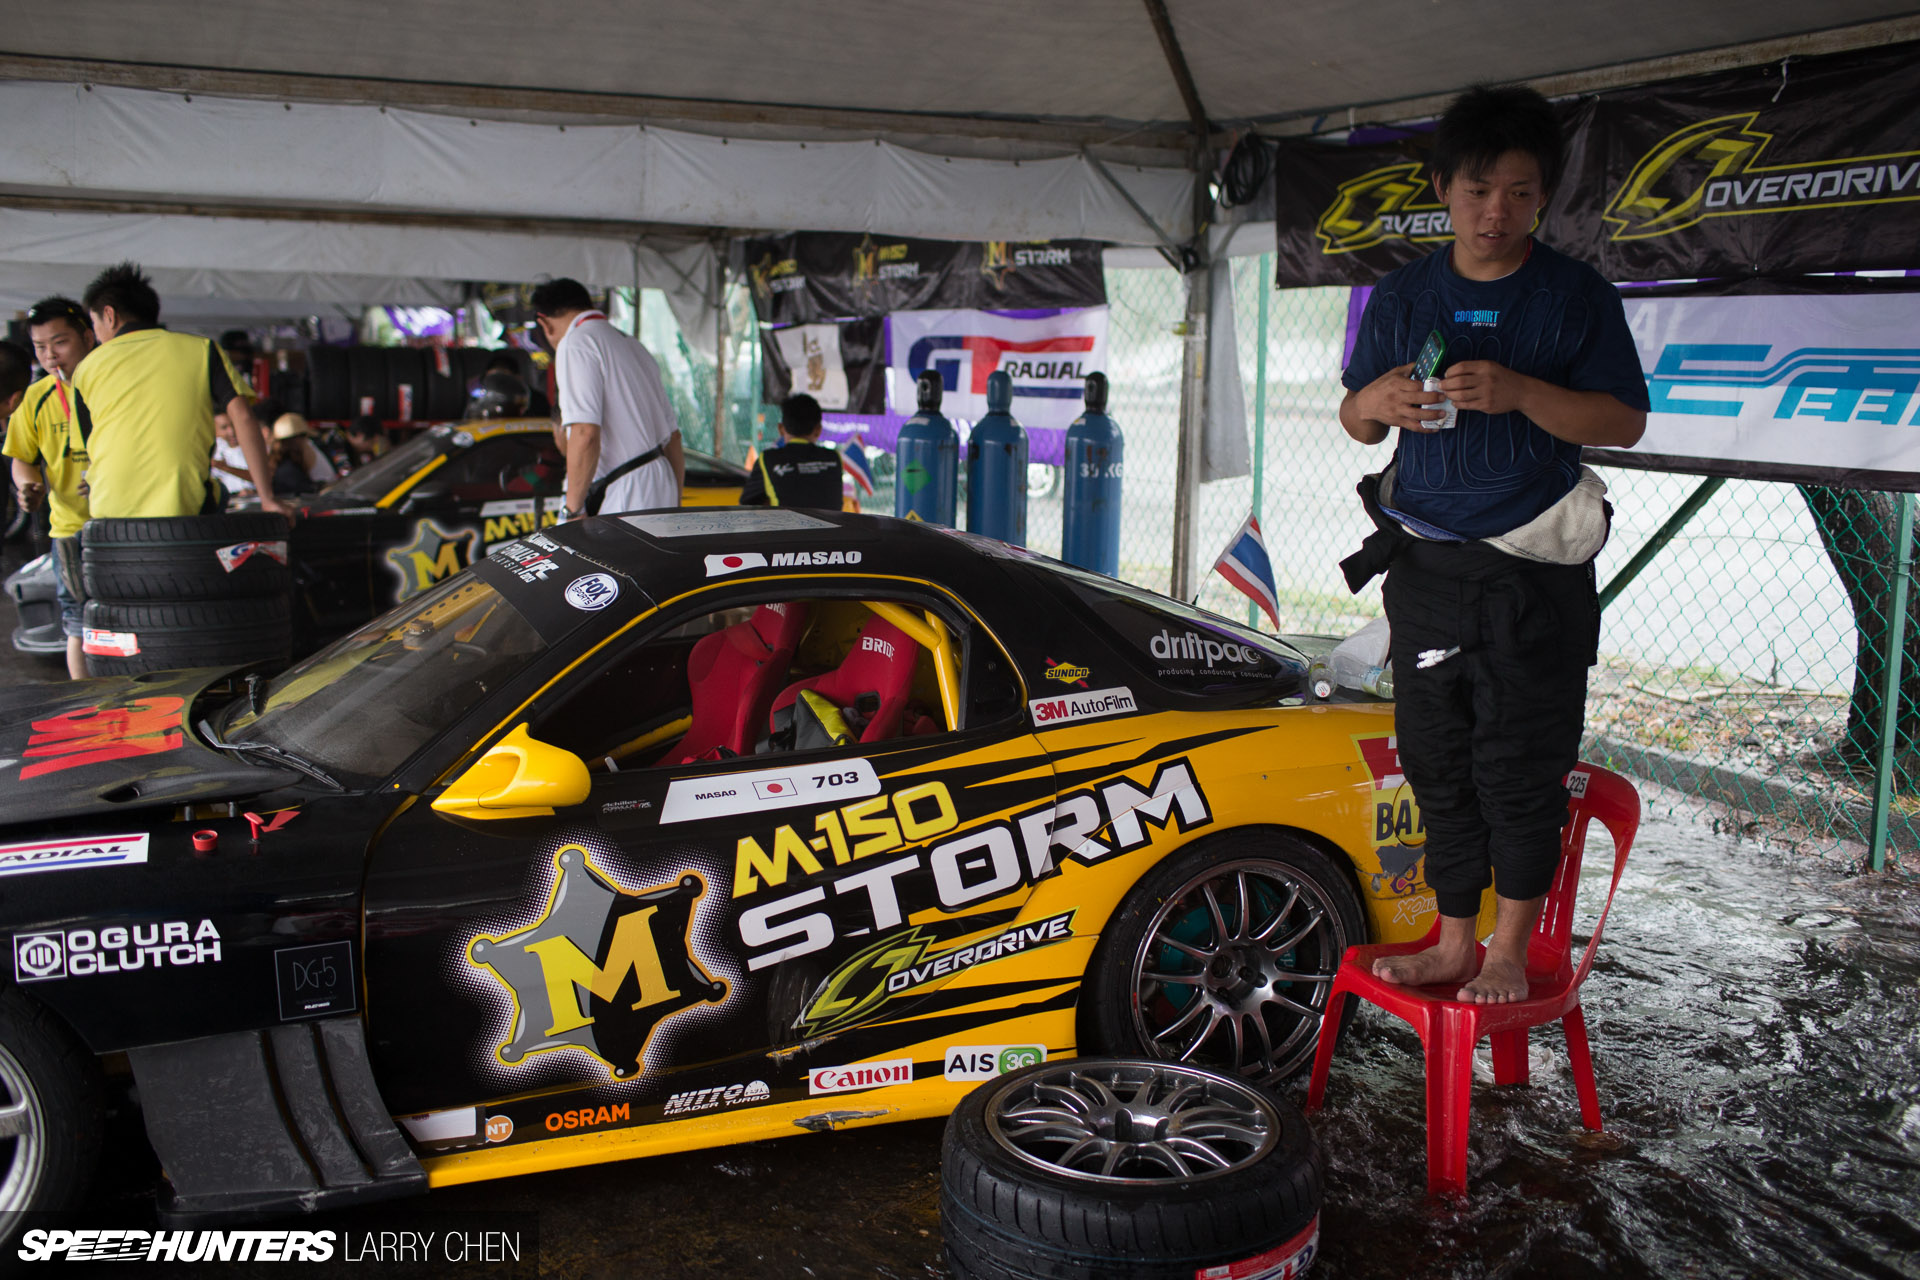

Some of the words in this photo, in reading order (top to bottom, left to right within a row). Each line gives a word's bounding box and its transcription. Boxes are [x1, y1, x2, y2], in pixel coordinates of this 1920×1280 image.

[1705, 161, 1920, 208] OVERDRIV
[1015, 248, 1072, 267] STORM
[1454, 309, 1501, 323] COOLSHIRT
[1003, 360, 1088, 380] RADIAL
[771, 551, 862, 567] MASAO
[571, 586, 593, 606] SPORTS
[580, 578, 612, 601] FOX
[1046, 667, 1089, 679] SUNOCO
[1158, 667, 1195, 677] producing
[1199, 668, 1237, 678] conducting
[1035, 700, 1069, 722] 3M
[1071, 694, 1134, 717] AutoFilm
[811, 771, 860, 789] 703
[1568, 774, 1587, 794] 225
[694, 789, 737, 801] MASAO
[731, 780, 960, 899] M-150
[737, 763, 1208, 972] STORM
[67, 918, 221, 953] OGURA
[68, 941, 222, 976] CLUTCH
[887, 914, 1070, 993] OVERDRIVE
[292, 956, 337, 992] DG-5
[948, 1053, 995, 1074] AIS
[1006, 1052, 1036, 1072] 3G
[813, 1064, 910, 1090] Canon
[663, 1101, 719, 1116] HEADER
[725, 1094, 771, 1106] TURBO
[664, 1083, 745, 1111] NITTO
[545, 1102, 631, 1132] OSRAM
